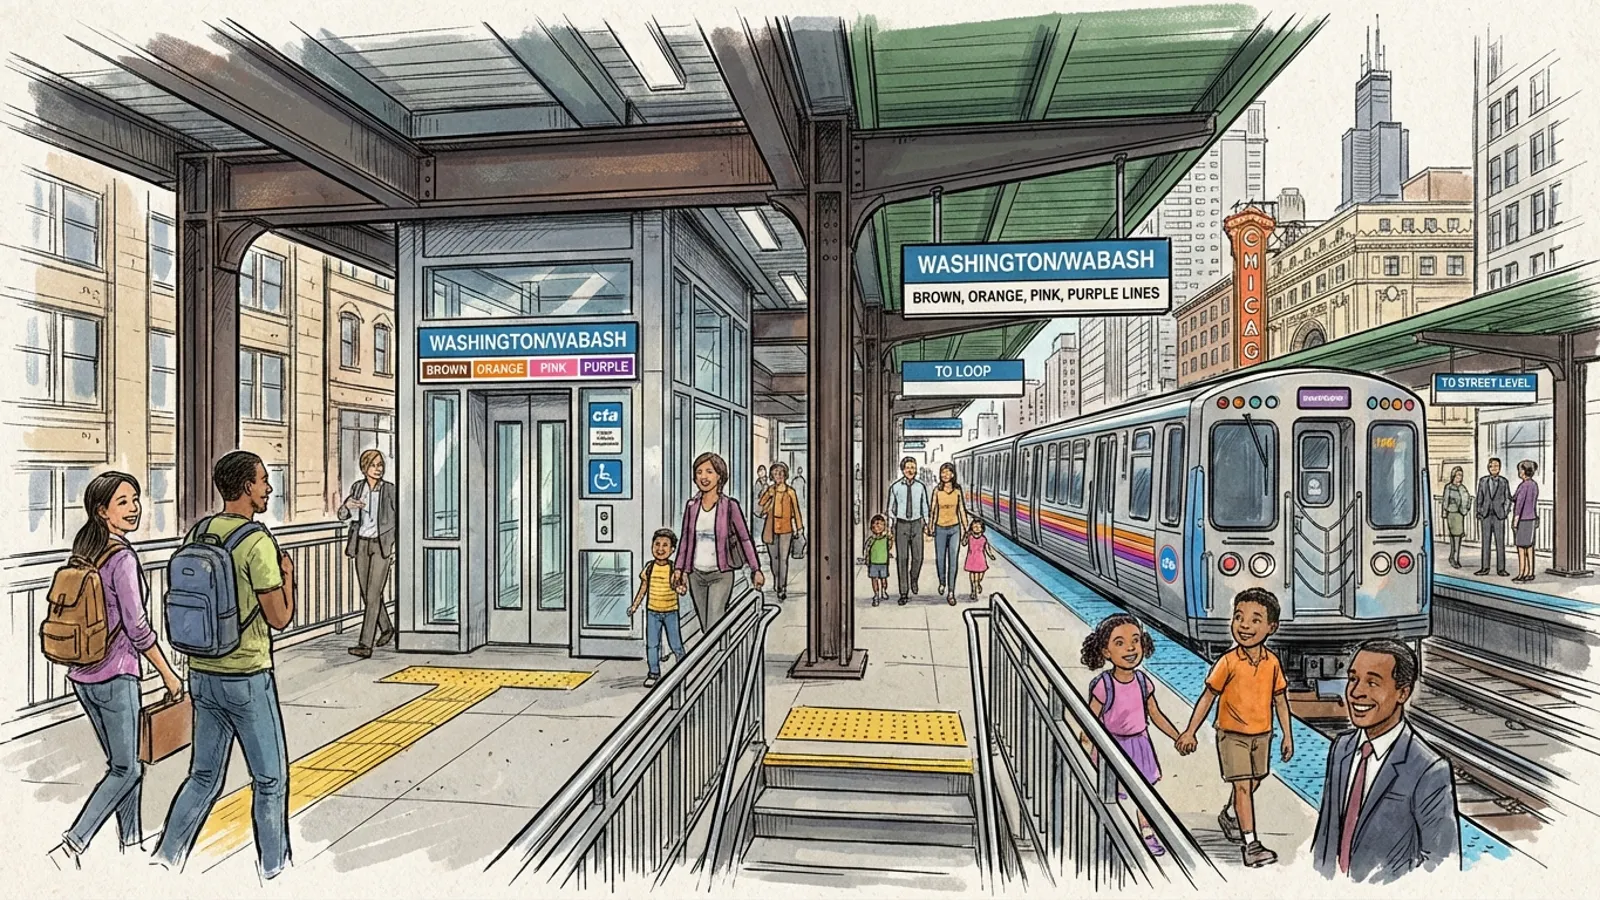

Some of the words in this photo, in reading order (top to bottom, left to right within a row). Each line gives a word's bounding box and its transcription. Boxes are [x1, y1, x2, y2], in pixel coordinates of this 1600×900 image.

[917, 249, 1155, 274] WASHINGTON/WABASH
[912, 290, 965, 305] BROWN,
[968, 289, 1027, 304] ORANGE,
[1030, 288, 1064, 302] PINK,
[1067, 287, 1118, 300] PURPLE
[1122, 286, 1160, 300] LINES
[429, 331, 627, 351] WASHINGTON/WABASH
[426, 364, 468, 375] BROWN
[476, 362, 524, 374] ORANGE
[540, 362, 567, 373] PINK
[584, 360, 629, 373] PURPLE
[935, 365, 953, 378] TO
[955, 365, 992, 377] LOOP
[1441, 377, 1456, 388] TO
[1457, 377, 1497, 388] STREET
[1499, 378, 1531, 388] LEVEL
